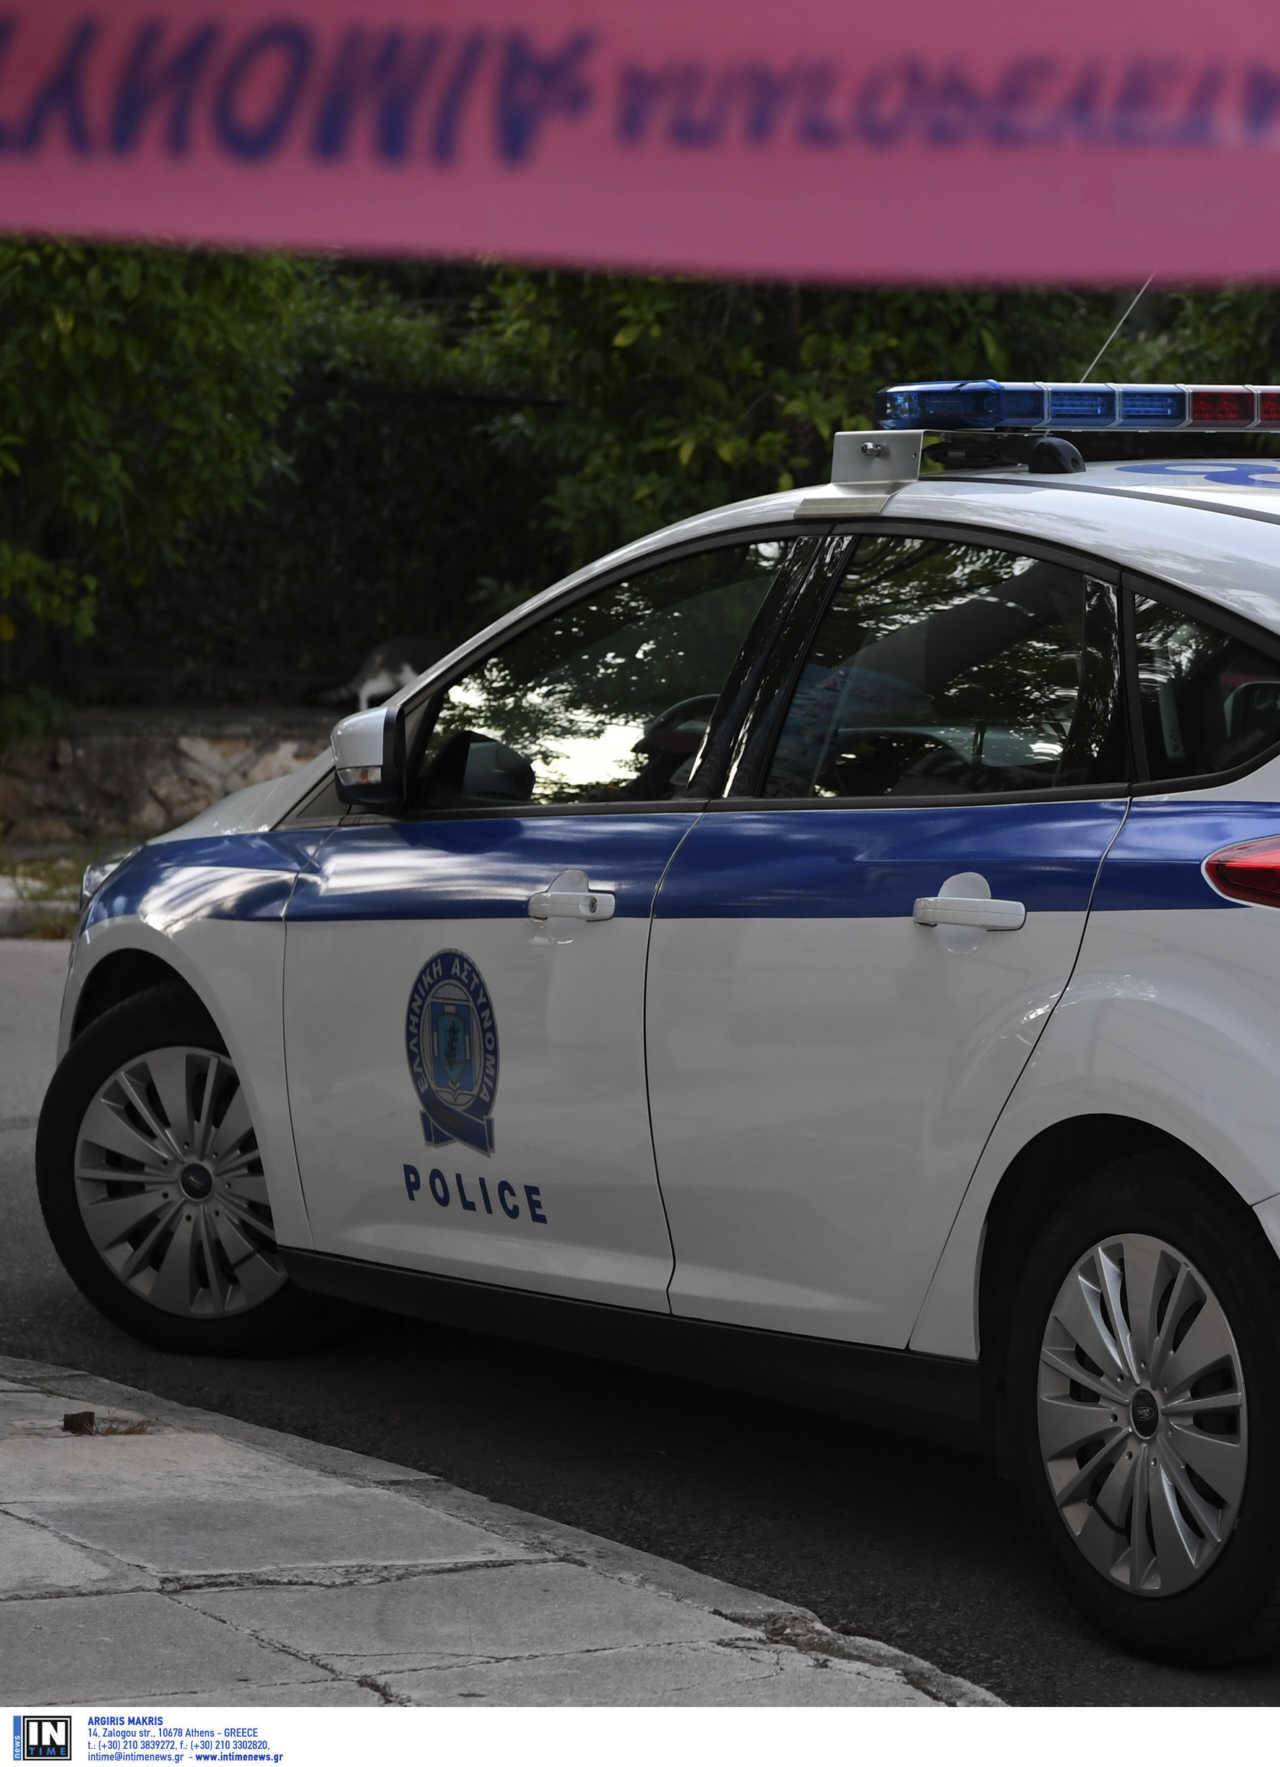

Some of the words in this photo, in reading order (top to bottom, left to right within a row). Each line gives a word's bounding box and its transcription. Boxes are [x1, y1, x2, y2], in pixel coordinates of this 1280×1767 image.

[406, 958, 443, 1094] ΕΛΛΗΝΙΚΗ
[450, 956, 498, 1103] ΑΣΤΥΝΟΜΙΑ
[403, 1163, 548, 1225] POLICE
